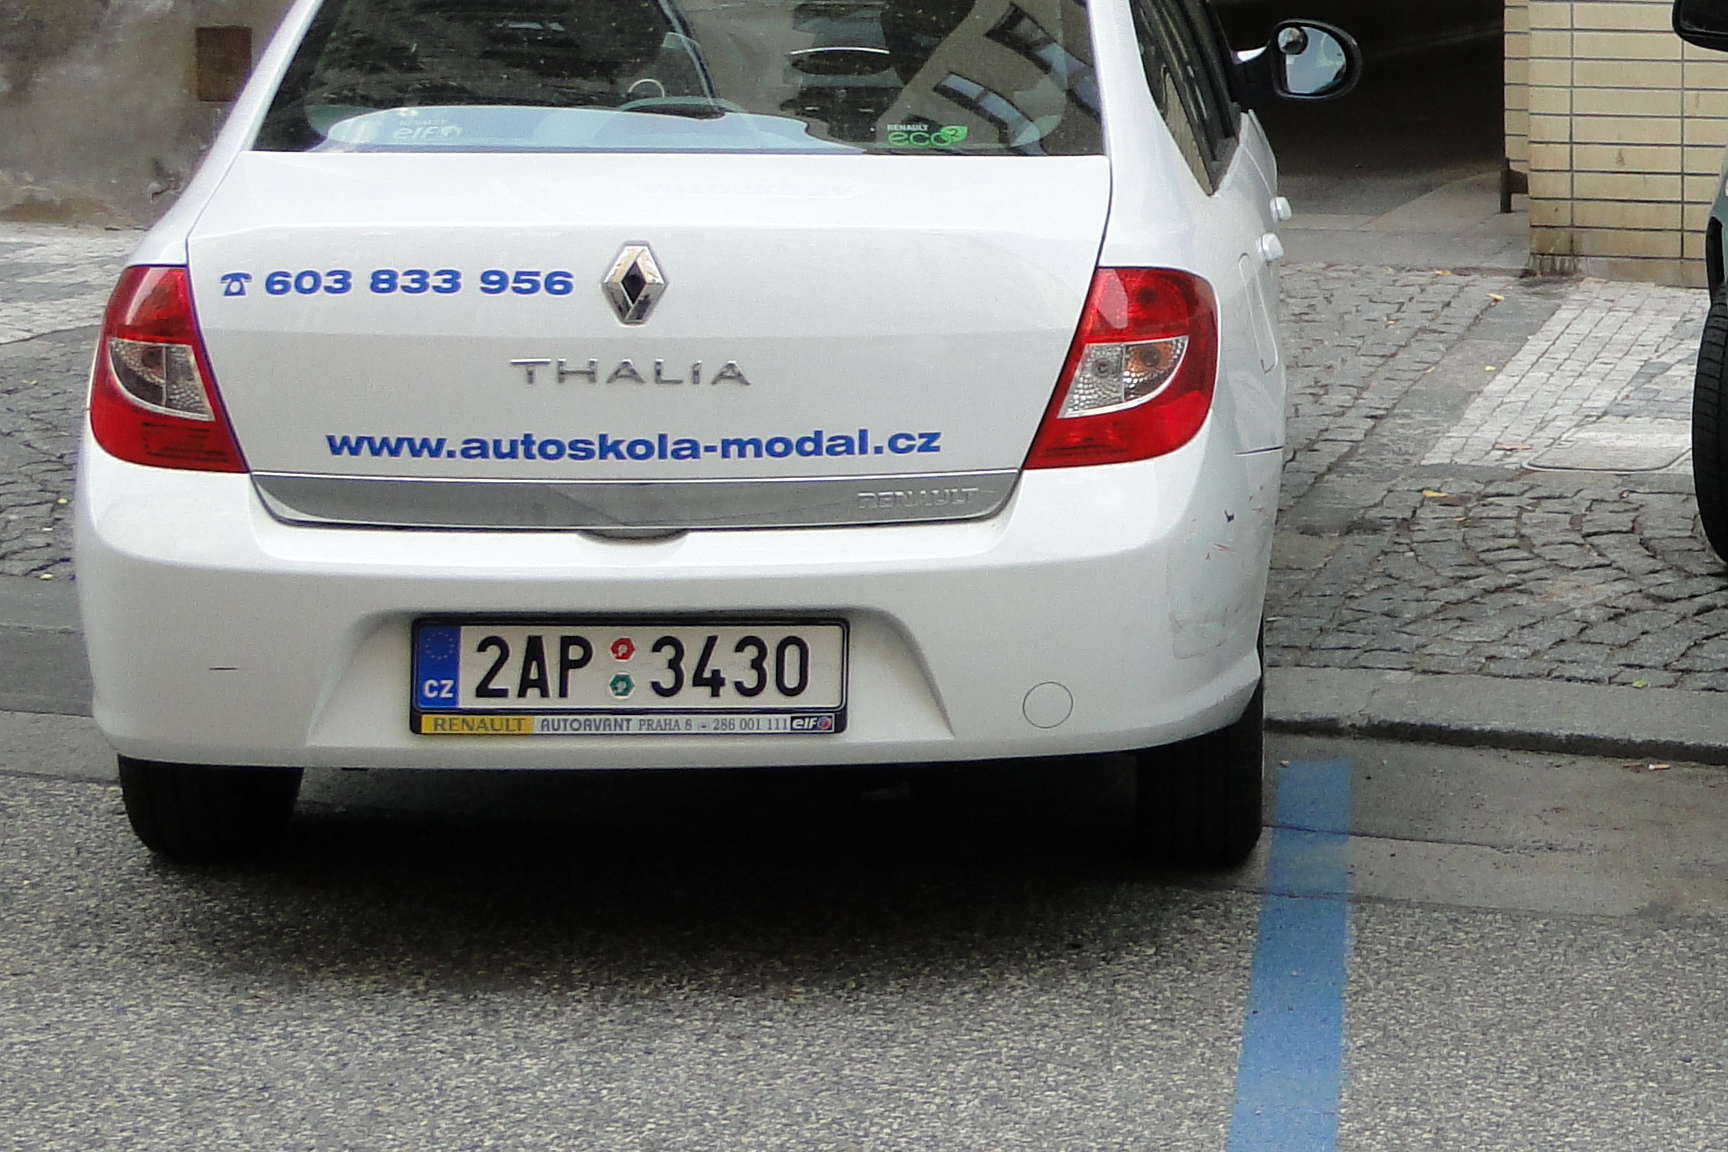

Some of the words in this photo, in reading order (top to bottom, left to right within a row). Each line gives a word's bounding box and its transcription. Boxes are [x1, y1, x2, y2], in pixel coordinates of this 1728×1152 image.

[265, 270, 353, 295] 603
[370, 269, 462, 294] 833
[480, 270, 574, 295] 956
[511, 359, 751, 385] THALIA
[325, 428, 942, 461] www.autoskola-modal.cz
[423, 679, 454, 698] CZ
[475, 635, 593, 698] 2AP
[651, 634, 810, 697] 3430
[433, 717, 525, 732] RENAULT
[638, 718, 681, 731] PRAHA
[685, 718, 692, 730] 8
[713, 718, 735, 730] 286
[740, 718, 765, 730] 001
[768, 718, 787, 730] 111
[792, 716, 817, 729] elf
